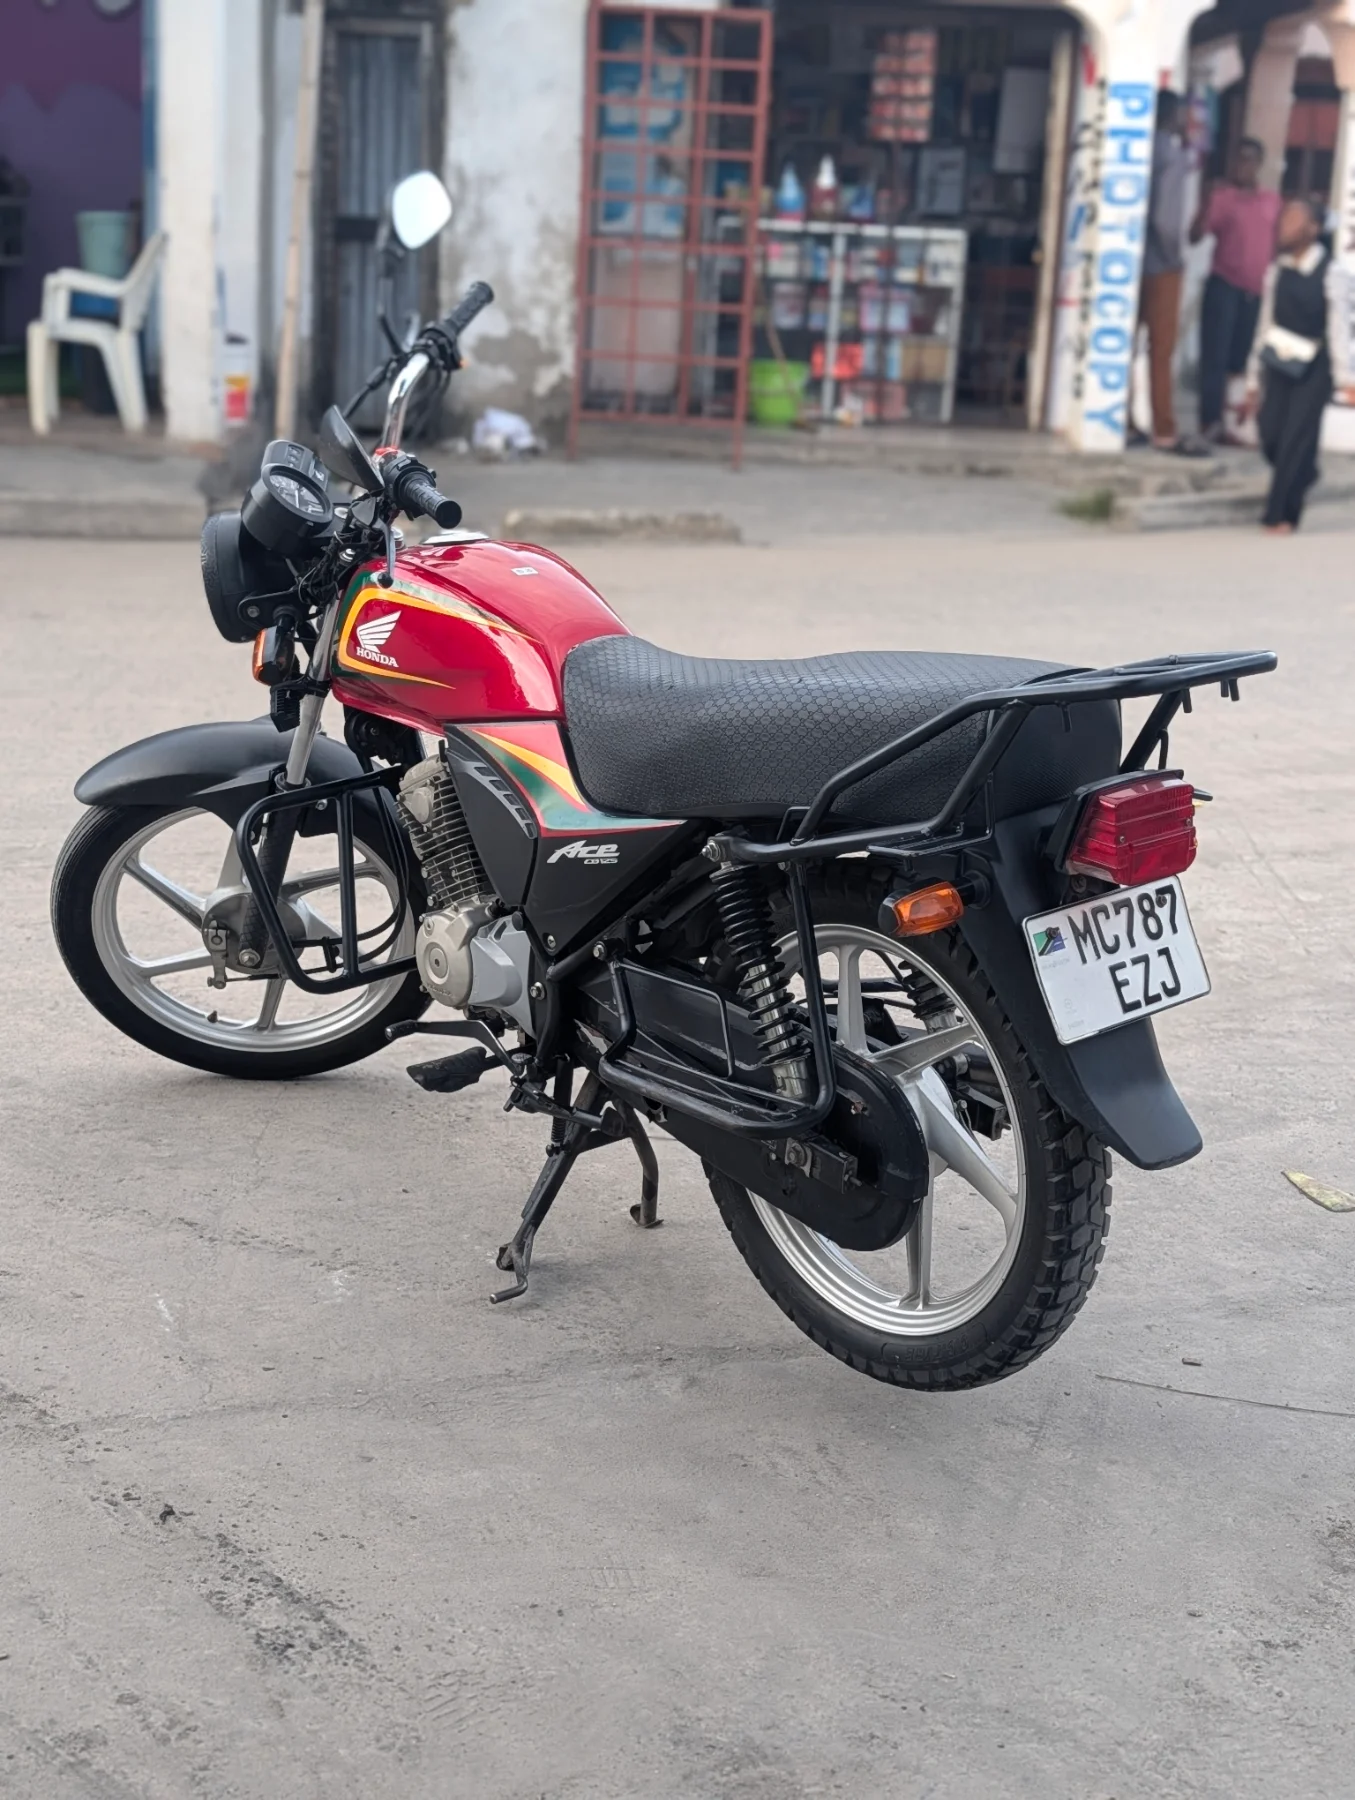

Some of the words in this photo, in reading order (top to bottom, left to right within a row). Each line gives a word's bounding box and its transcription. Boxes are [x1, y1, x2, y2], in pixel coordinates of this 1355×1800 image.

[1084, 82, 1152, 434] PHOTOCOPY
[356, 646, 399, 668] HONDA
[547, 840, 620, 864] Ace
[1067, 884, 1178, 965] MC787
[1108, 946, 1181, 1014] EZJ
